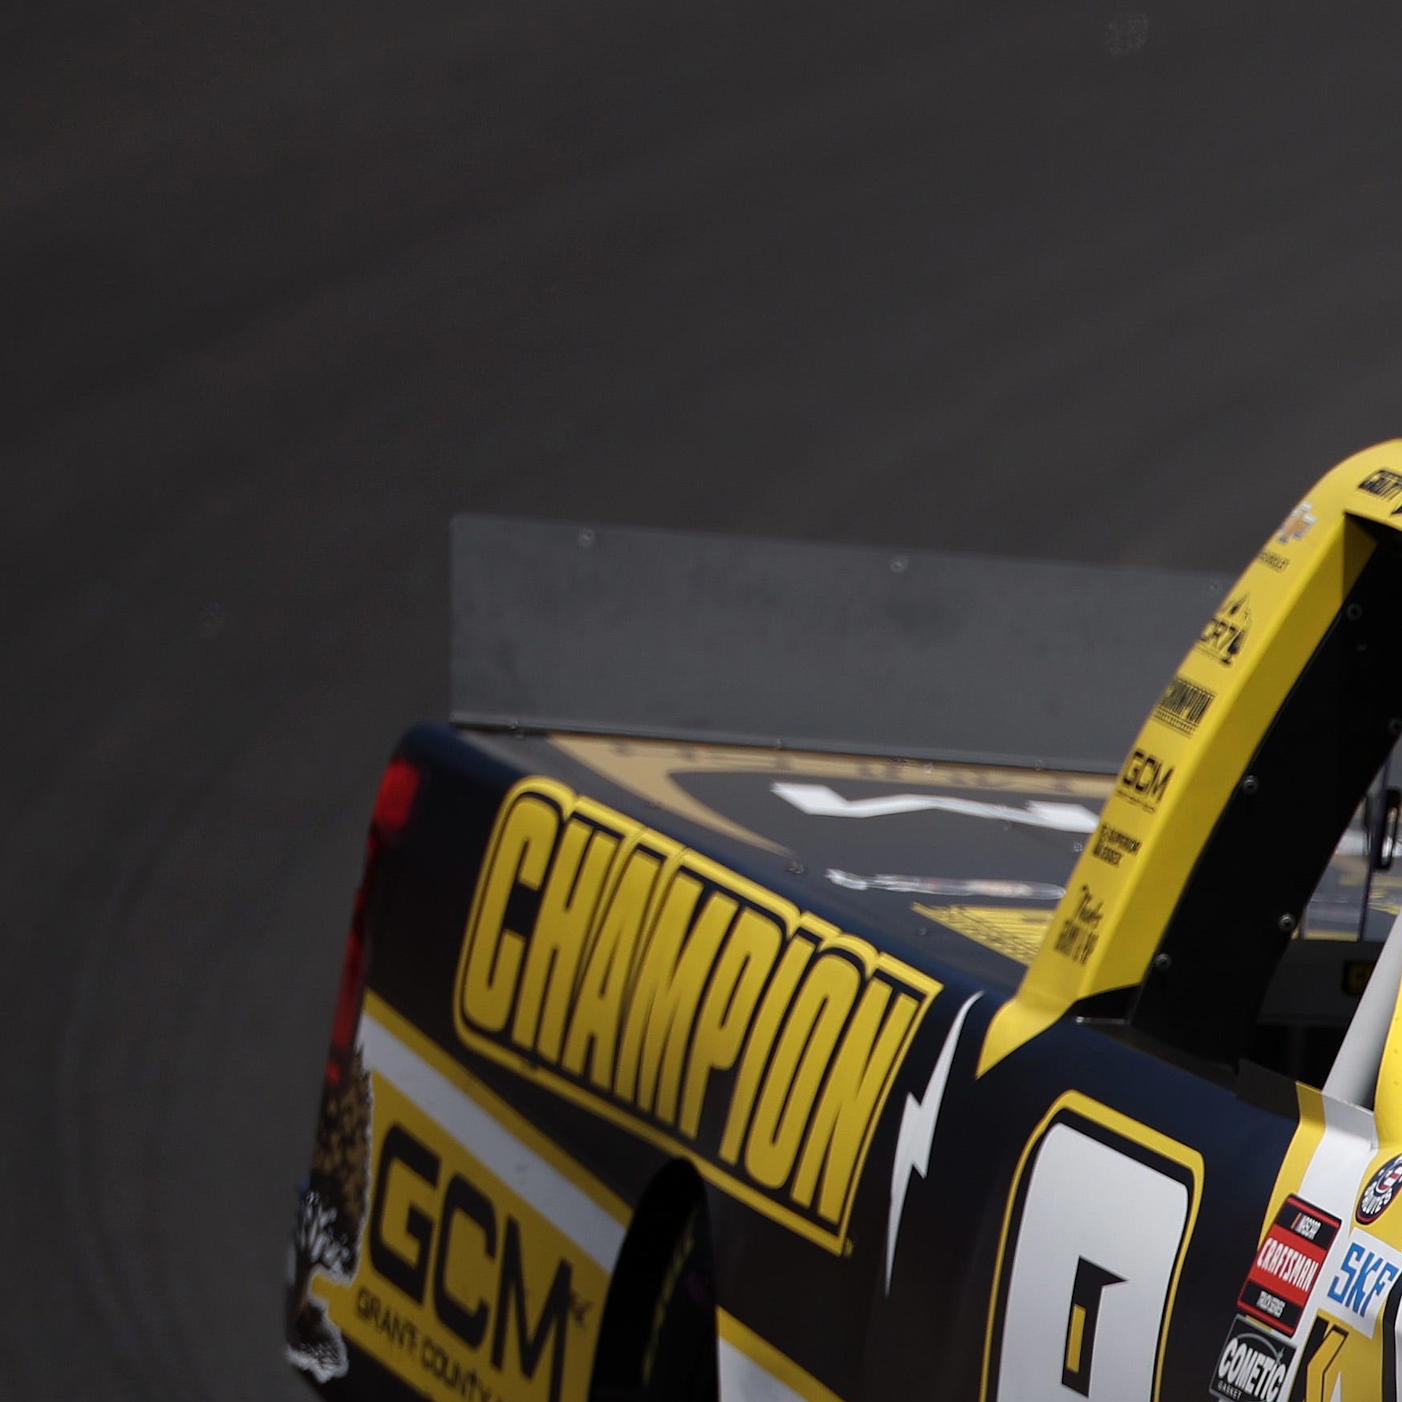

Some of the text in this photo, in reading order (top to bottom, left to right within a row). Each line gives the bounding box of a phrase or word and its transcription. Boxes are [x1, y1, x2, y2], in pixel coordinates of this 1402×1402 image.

[1121, 749, 1174, 802] GCM
[458, 790, 928, 1232] CHAMPION
[1256, 1236, 1320, 1292] CRAFTSMAN
[1326, 1241, 1400, 1319] SKF
[1217, 1381, 1243, 1400] GASKET
